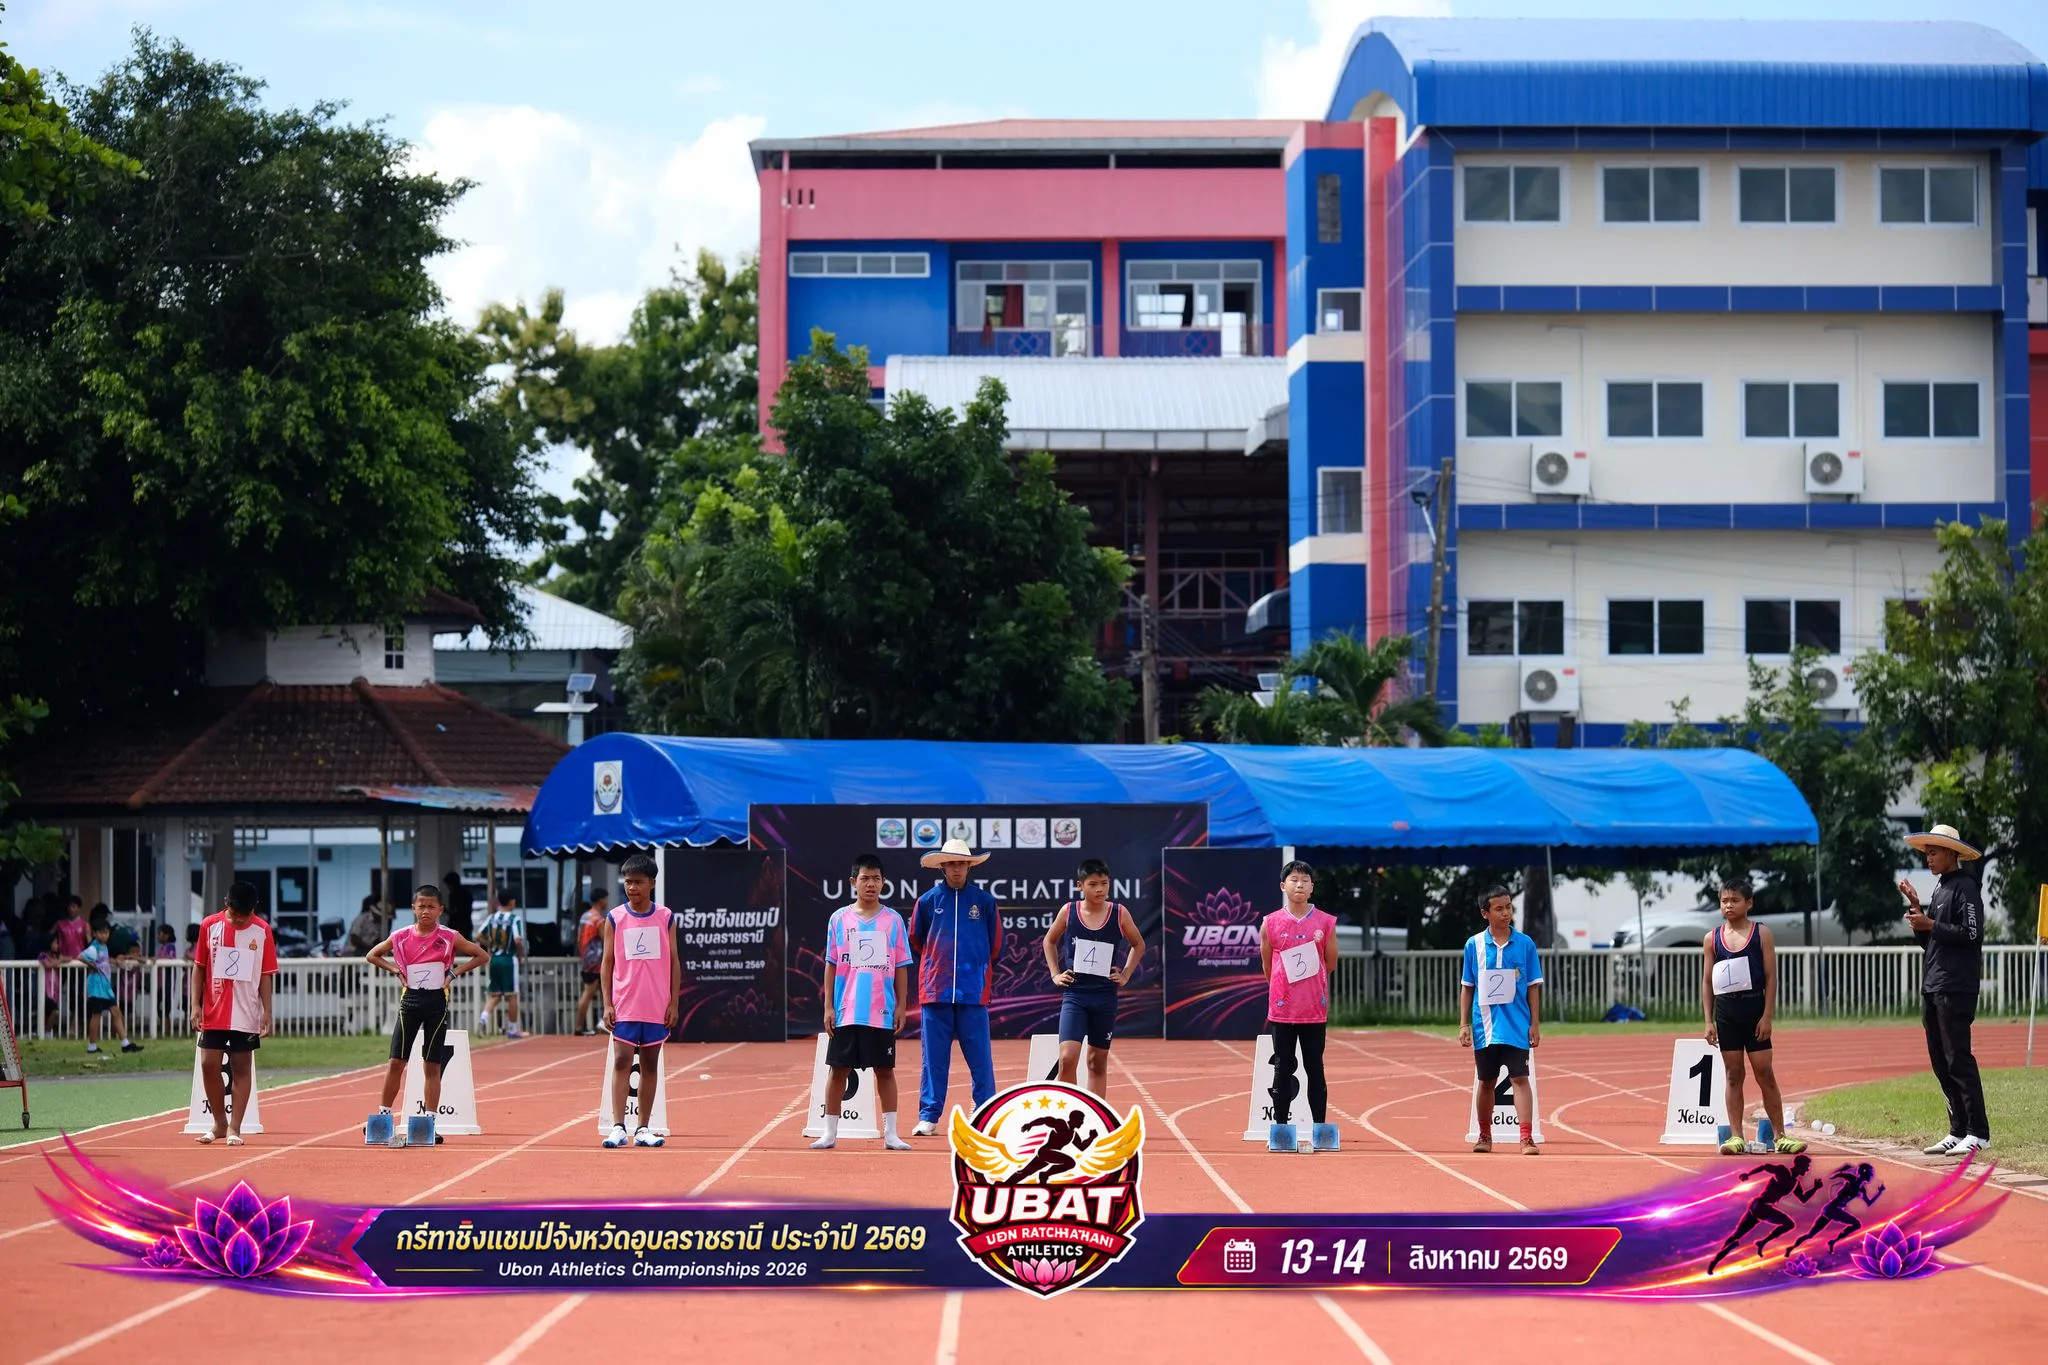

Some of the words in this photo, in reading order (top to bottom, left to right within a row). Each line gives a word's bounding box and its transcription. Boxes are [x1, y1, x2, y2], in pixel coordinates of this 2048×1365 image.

[935, 878, 1141, 899] TCHATHNI
[1967, 902, 1977, 926] NIKE
[635, 932, 647, 952] 6
[685, 929, 764, 948] จ.อุบลราชธานี
[1182, 925, 1261, 945] UBON
[859, 939, 874, 961] 5
[1083, 947, 1098, 967] 4
[225, 950, 240, 976] 8
[686, 961, 711, 970] 12-14
[745, 960, 765, 969] 2569
[1292, 953, 1307, 977] 3
[414, 970, 431, 988] 7
[1488, 974, 1504, 997] 2
[1721, 964, 1739, 989] 1
[1689, 1054, 1713, 1107] 1
[416, 1100, 454, 1115] Nco
[1678, 1108, 1715, 1125] Nelco
[1491, 1111, 1520, 1125] elco
